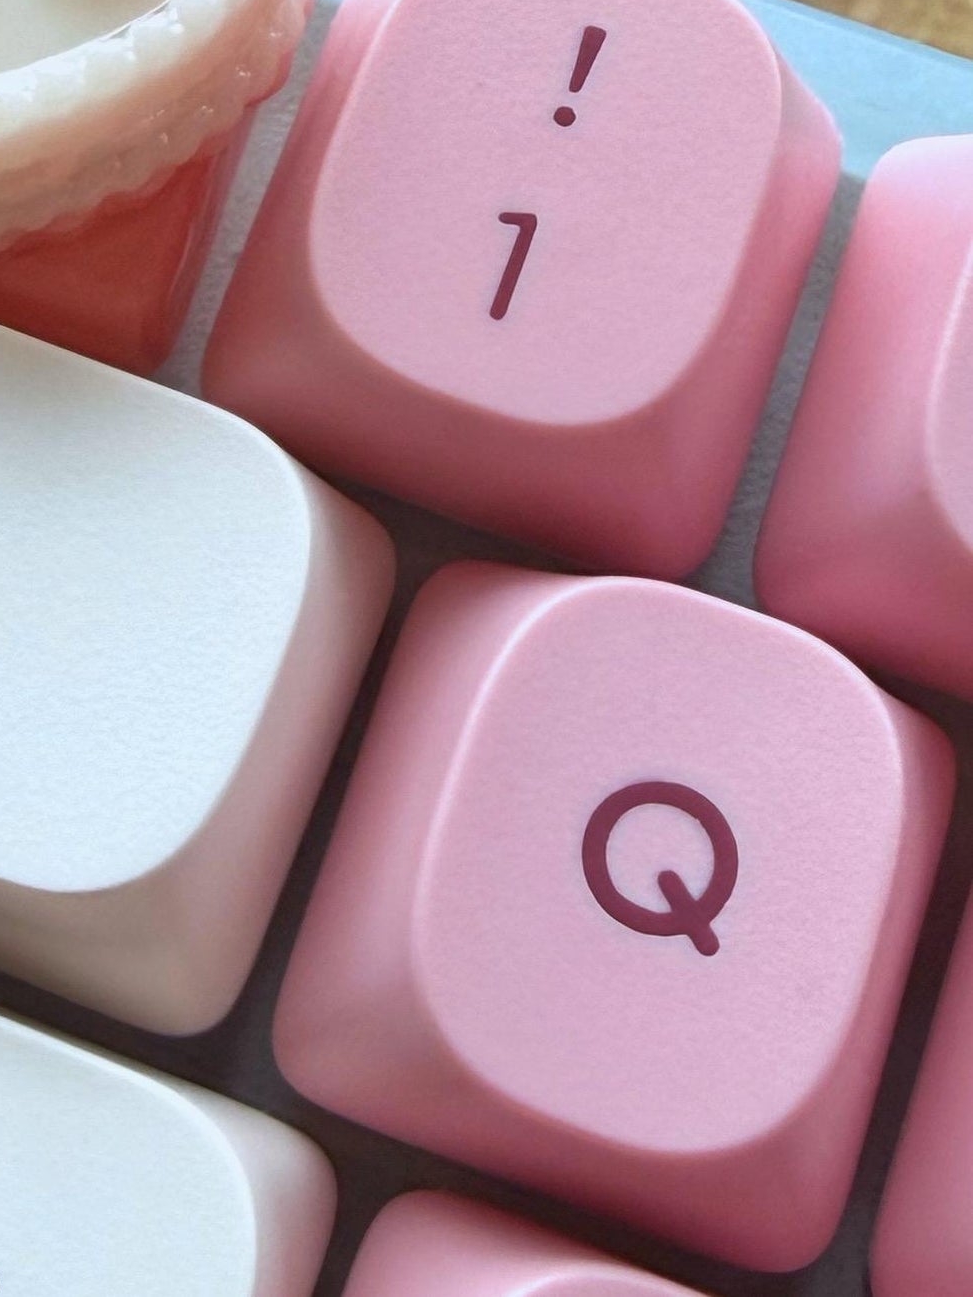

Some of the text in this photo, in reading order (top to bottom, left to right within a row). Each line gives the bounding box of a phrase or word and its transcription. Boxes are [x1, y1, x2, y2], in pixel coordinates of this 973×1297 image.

[552, 24, 608, 129] !
[489, 211, 539, 322] 1
[580, 779, 740, 958] Q
